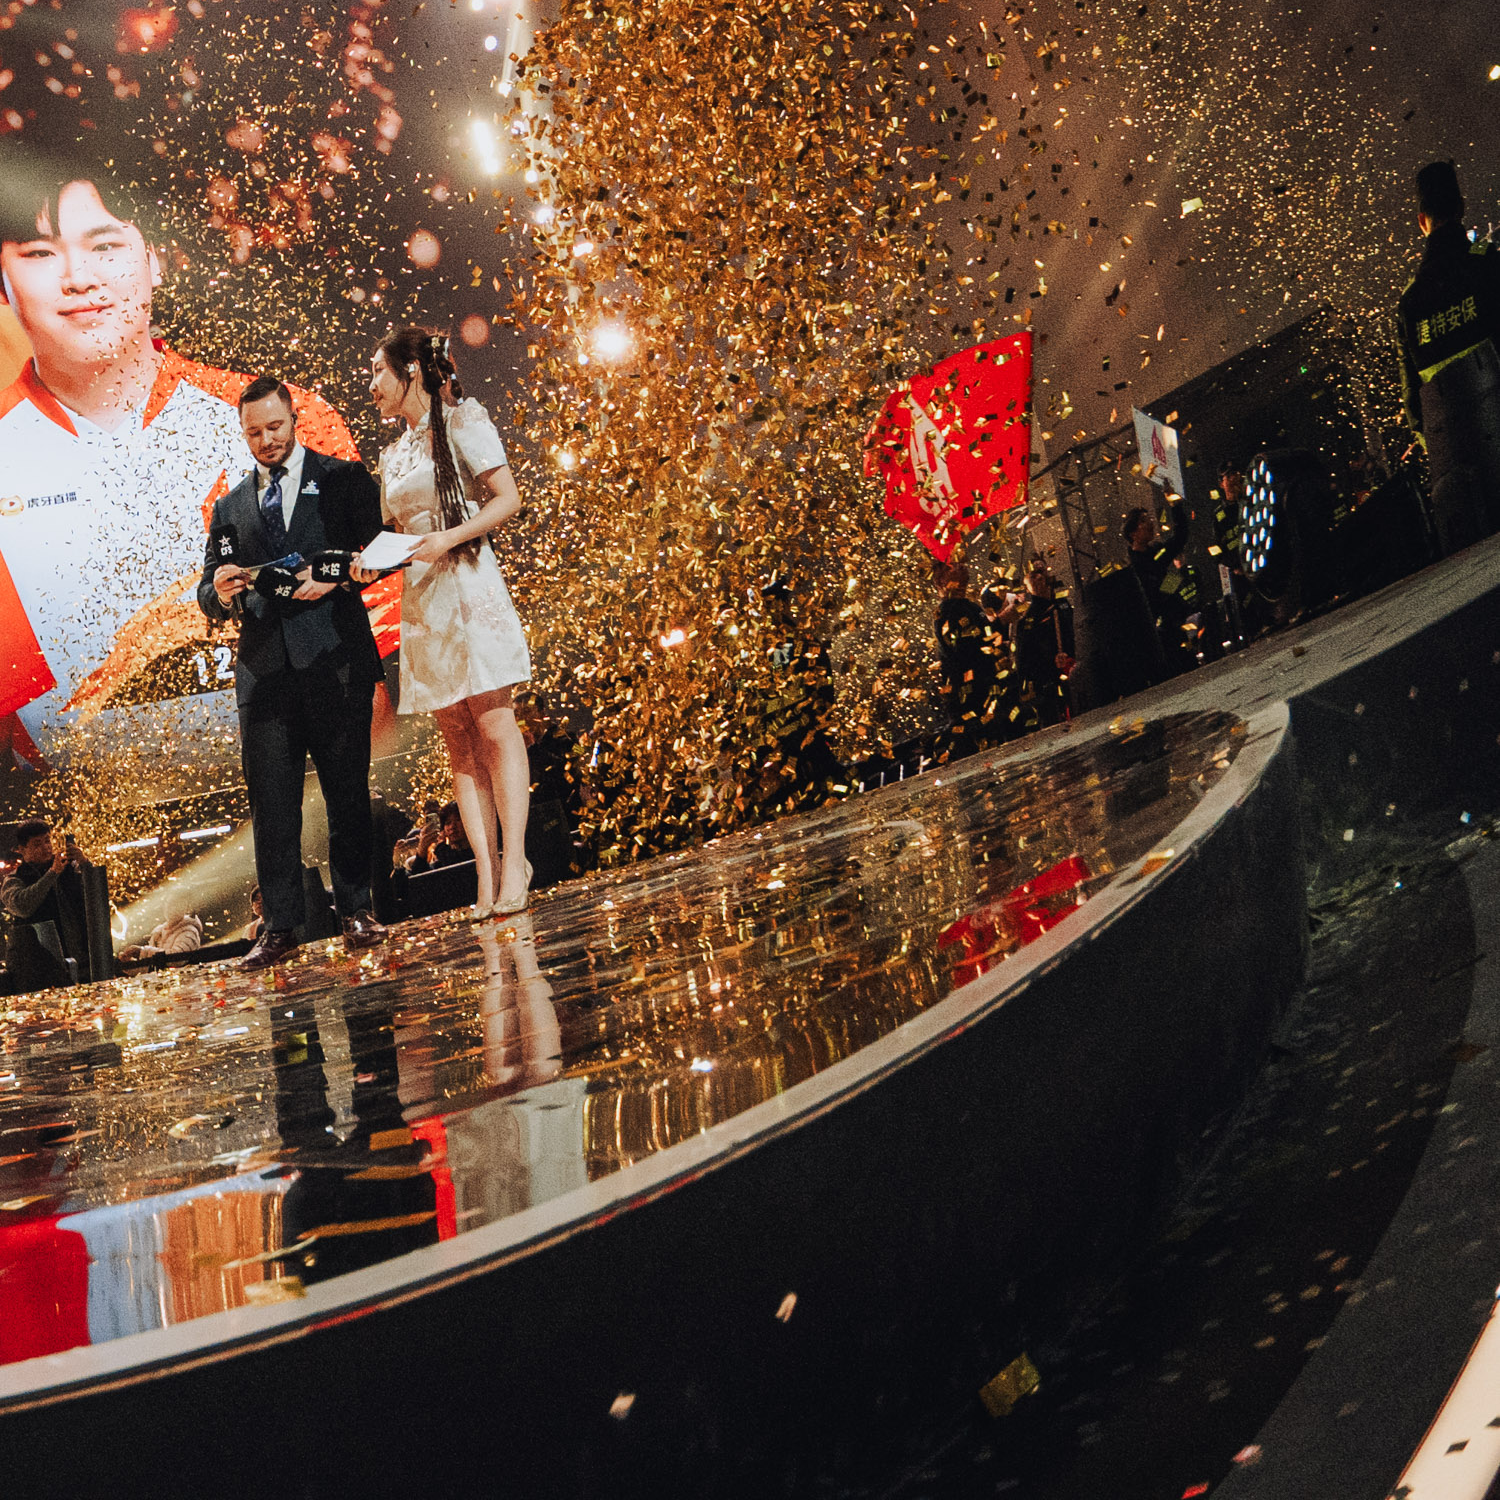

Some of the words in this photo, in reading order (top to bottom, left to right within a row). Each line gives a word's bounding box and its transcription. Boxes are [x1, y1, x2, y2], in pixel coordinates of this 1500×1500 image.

[27, 492, 78, 509] 虎牙直播
[220, 545, 233, 556] CFS
